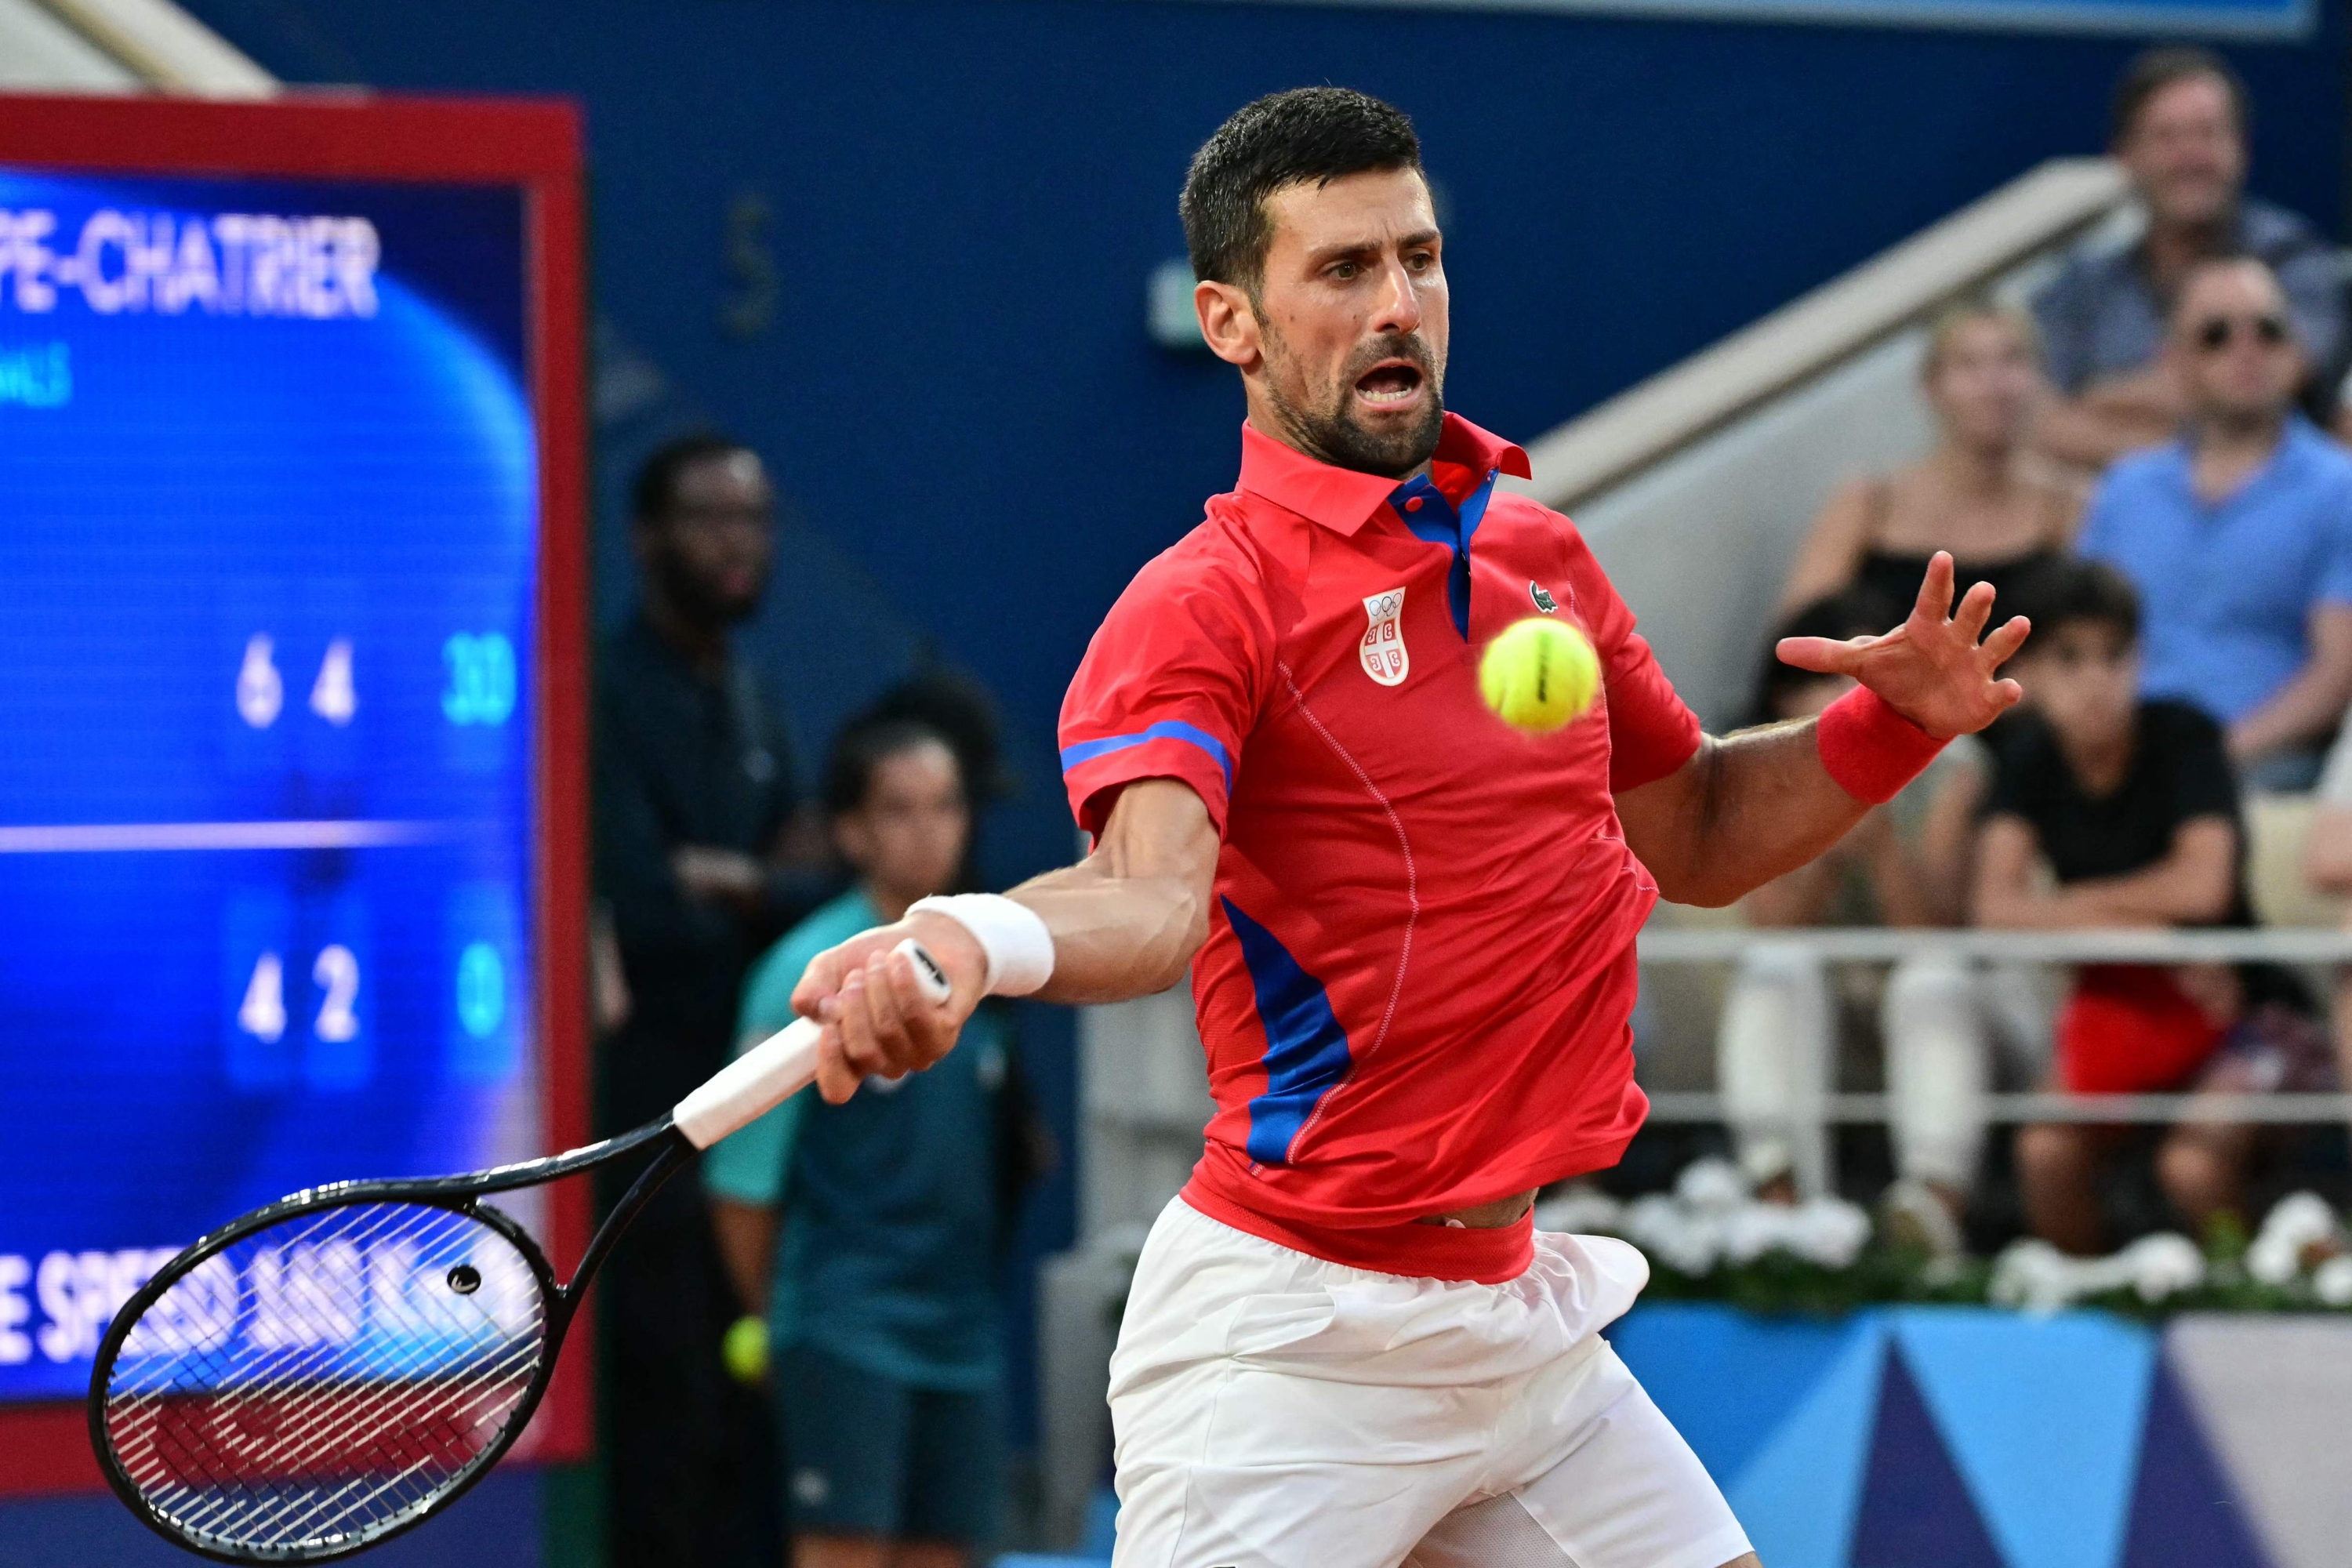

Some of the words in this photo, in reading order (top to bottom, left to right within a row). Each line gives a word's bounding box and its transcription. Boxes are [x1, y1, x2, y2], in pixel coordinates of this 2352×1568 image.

[237, 632, 284, 728] 6
[311, 635, 358, 728] 4
[238, 952, 287, 1044] 4
[314, 944, 359, 1043] 2
[457, 943, 504, 1039] 0
